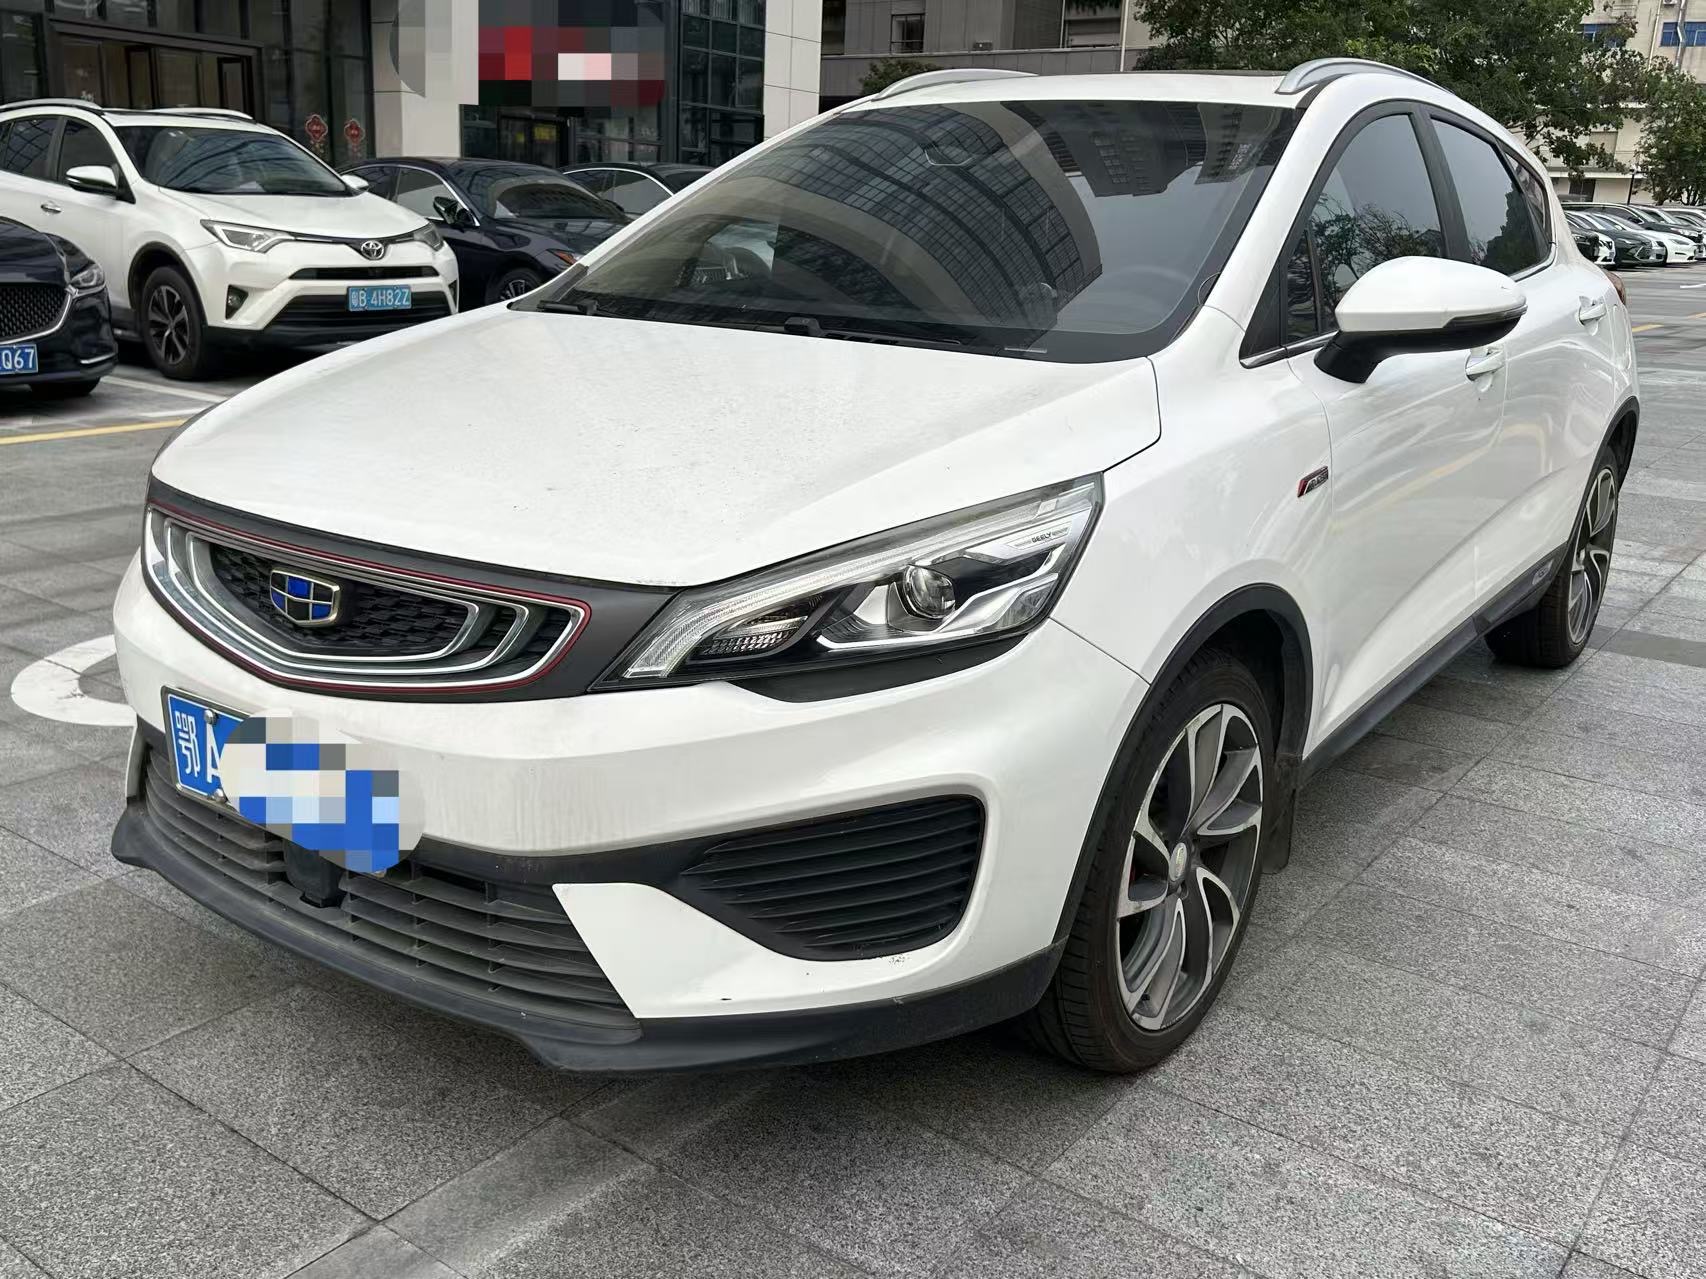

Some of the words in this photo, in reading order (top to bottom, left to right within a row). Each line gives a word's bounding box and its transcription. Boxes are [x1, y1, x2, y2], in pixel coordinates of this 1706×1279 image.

[371, 288, 410, 306] 4H82Z
[0, 348, 35, 370] Q67
[1031, 531, 1052, 543] GEELY
